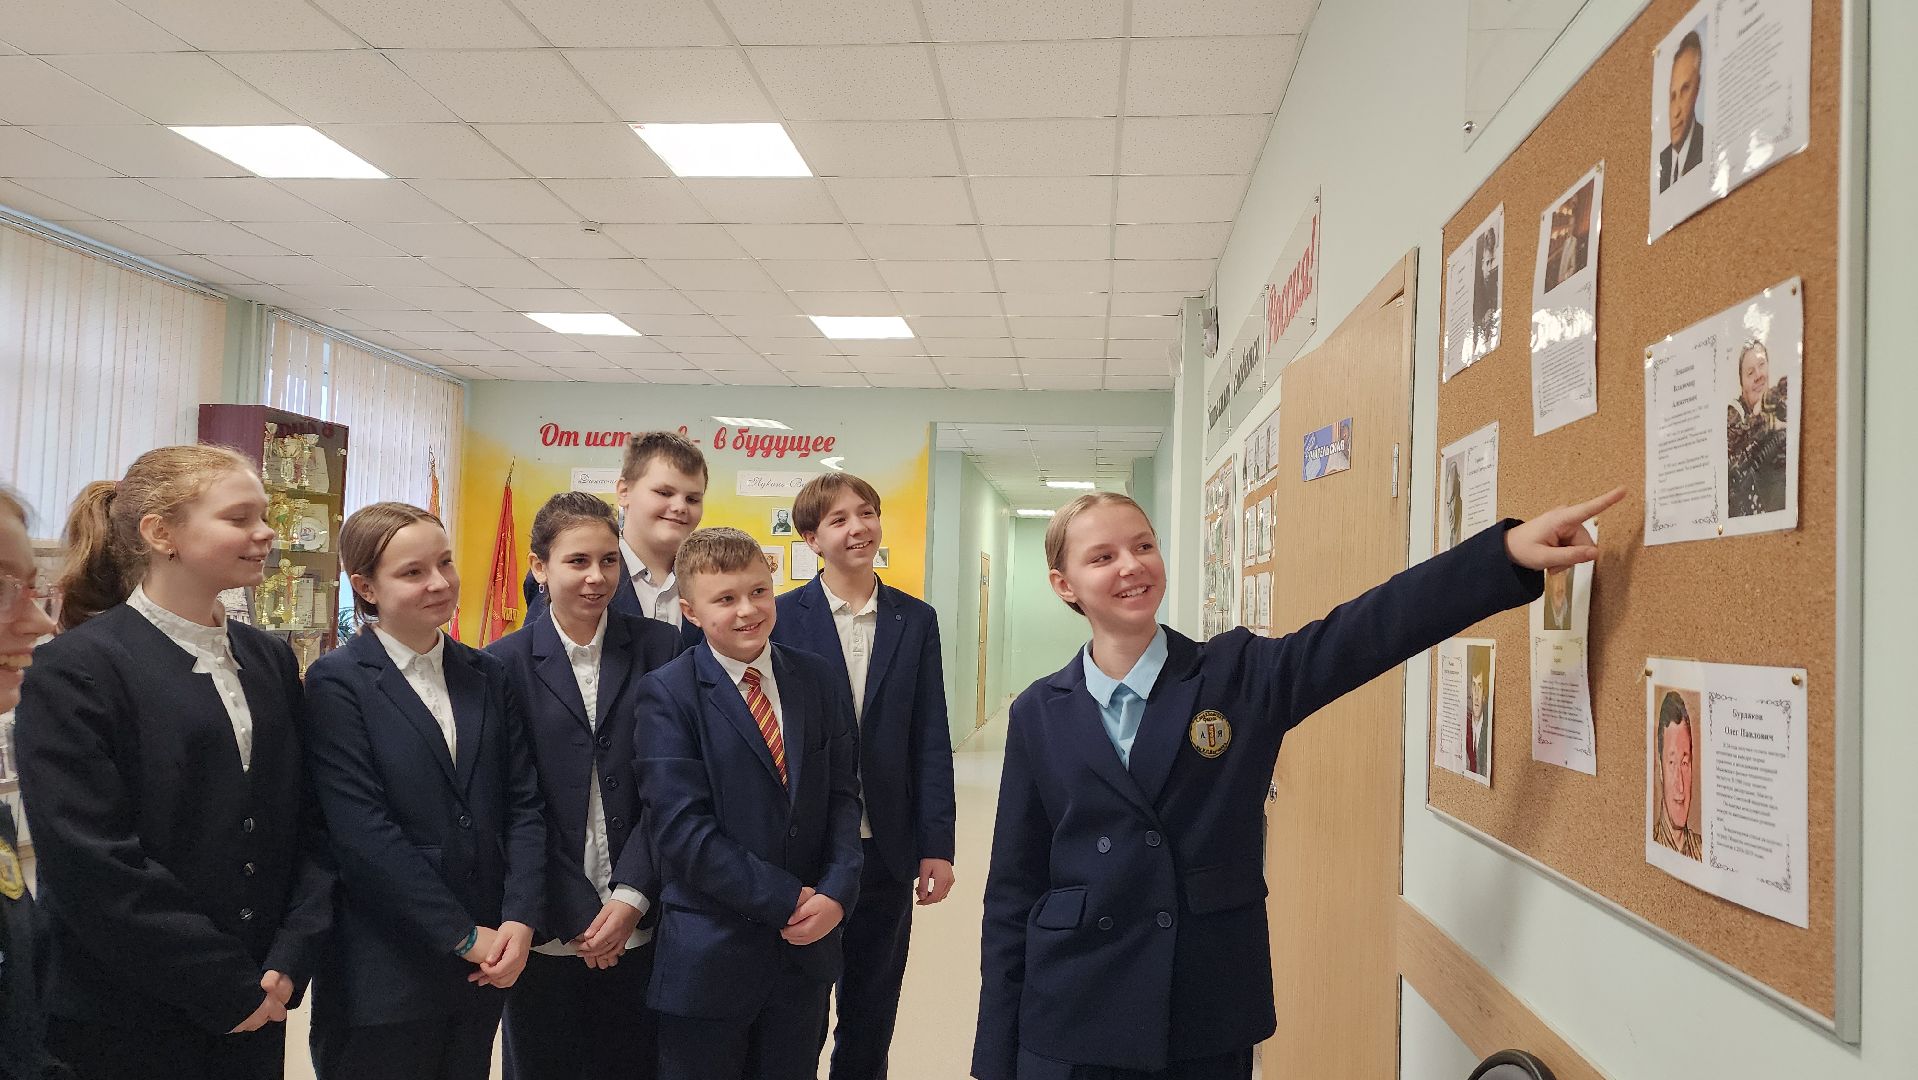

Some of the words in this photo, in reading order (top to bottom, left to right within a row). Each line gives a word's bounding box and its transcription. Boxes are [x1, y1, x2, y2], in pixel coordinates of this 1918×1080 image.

[1267, 214, 1317, 354] Россия!
[540, 422, 580, 447] От
[713, 426, 727, 450] в
[732, 427, 836, 458] будущее
[1724, 726, 1739, 736] Олег
[1740, 728, 1774, 741] Павлович
